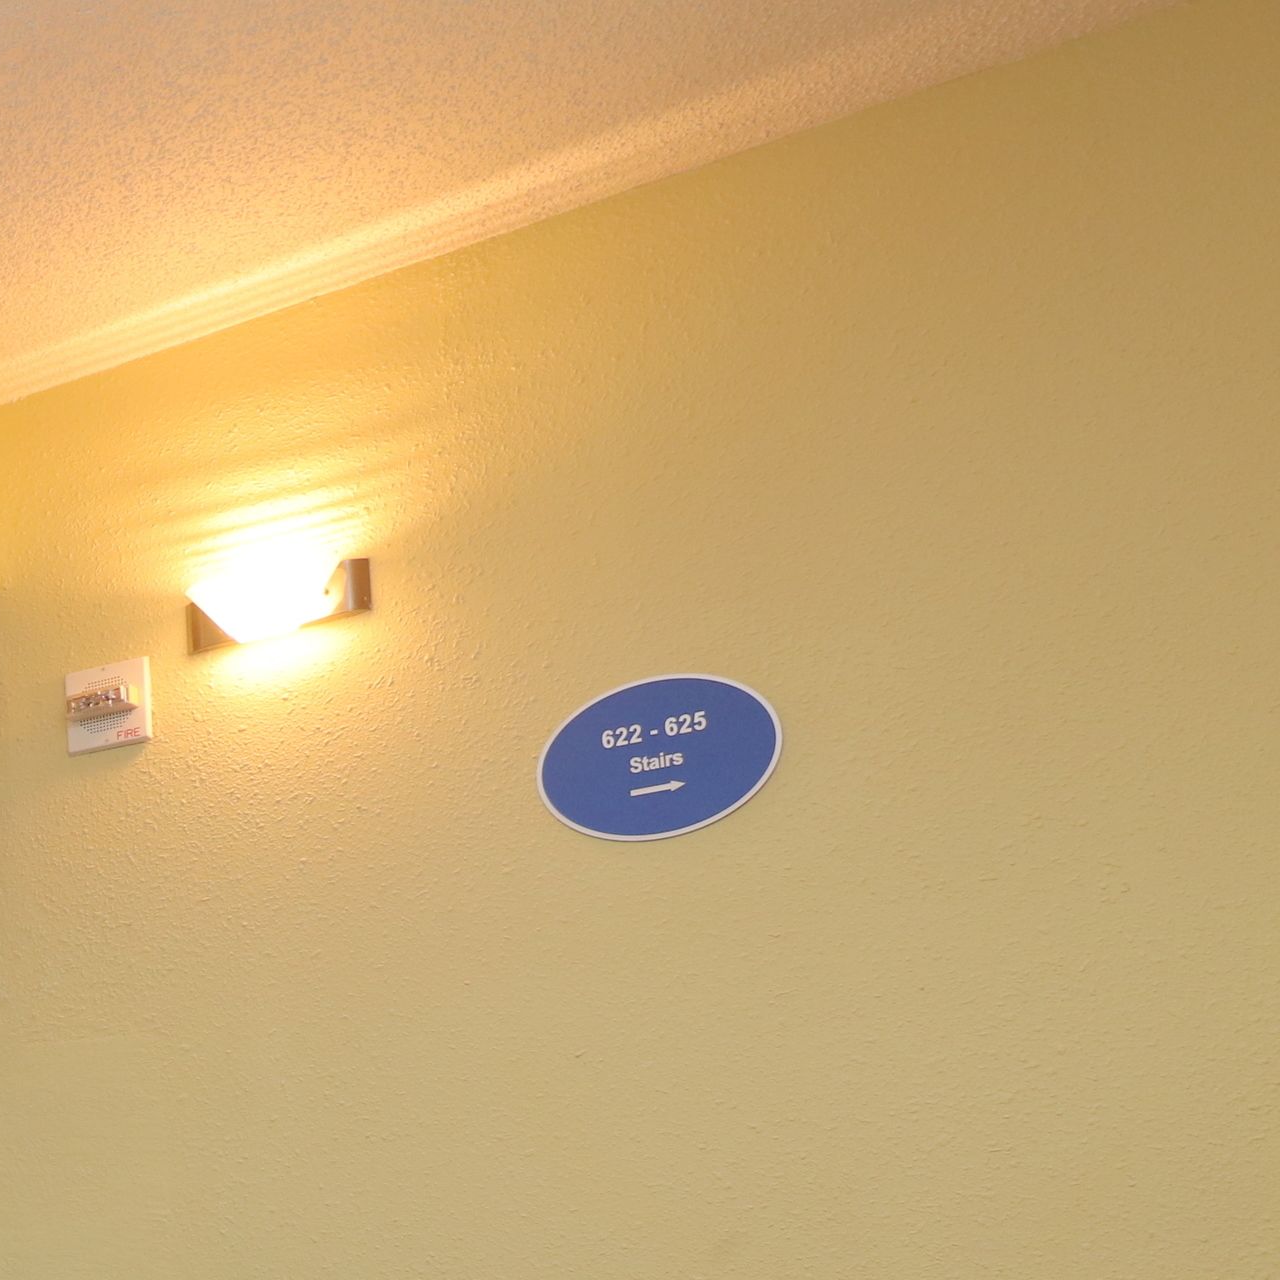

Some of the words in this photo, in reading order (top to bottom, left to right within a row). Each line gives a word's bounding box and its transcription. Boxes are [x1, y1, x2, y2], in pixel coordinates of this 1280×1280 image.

[116, 726, 141, 740] FIRE
[601, 723, 642, 749] 622
[664, 710, 707, 736] 625
[629, 752, 684, 773] Stairs
